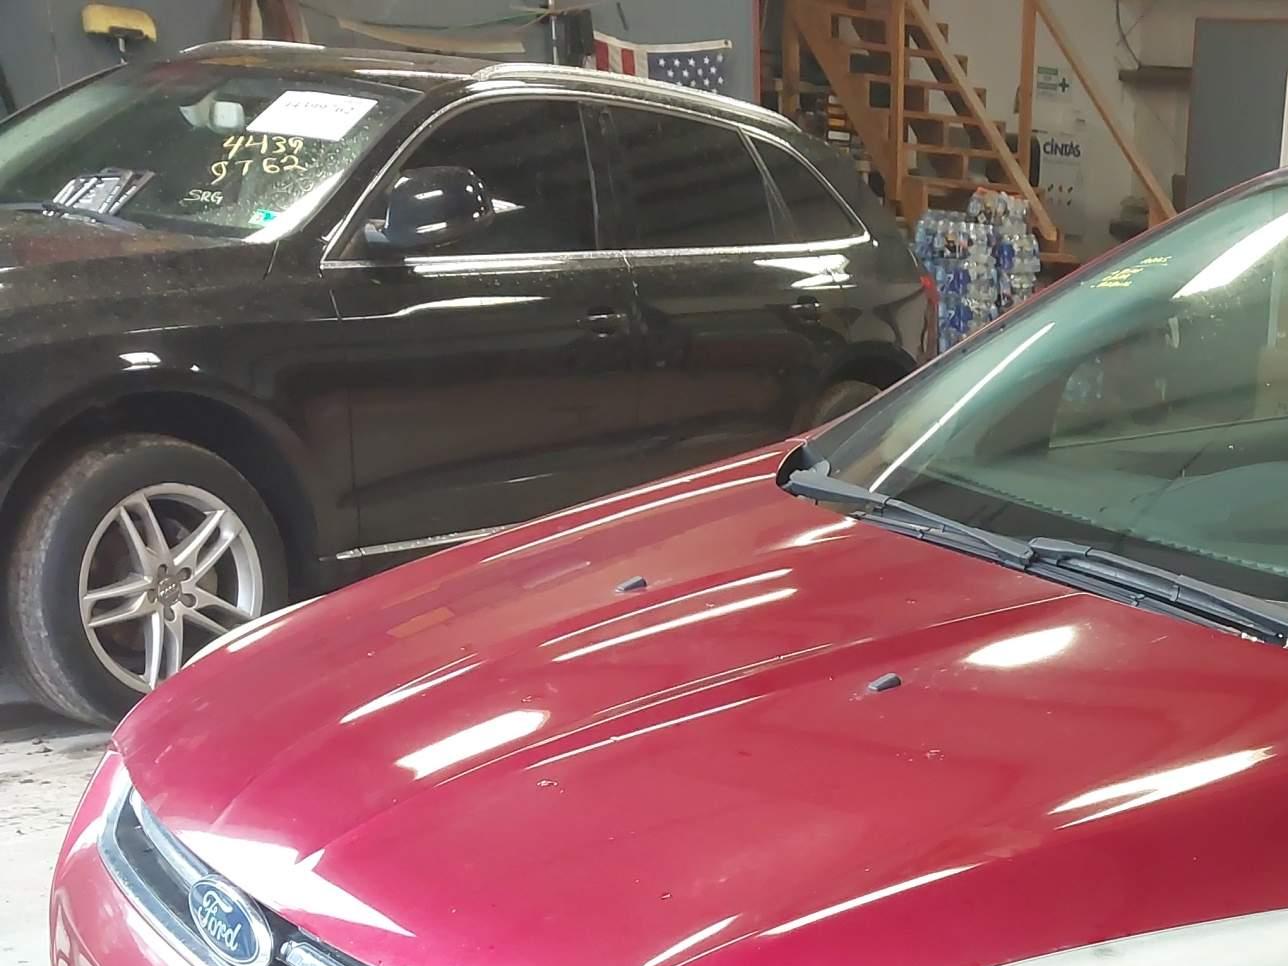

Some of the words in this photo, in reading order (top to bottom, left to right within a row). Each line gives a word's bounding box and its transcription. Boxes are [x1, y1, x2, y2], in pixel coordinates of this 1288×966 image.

[222, 135, 304, 160] 4439
[1043, 138, 1081, 158] CINTAS
[183, 189, 224, 205] SRG
[198, 890, 241, 950] Ford
